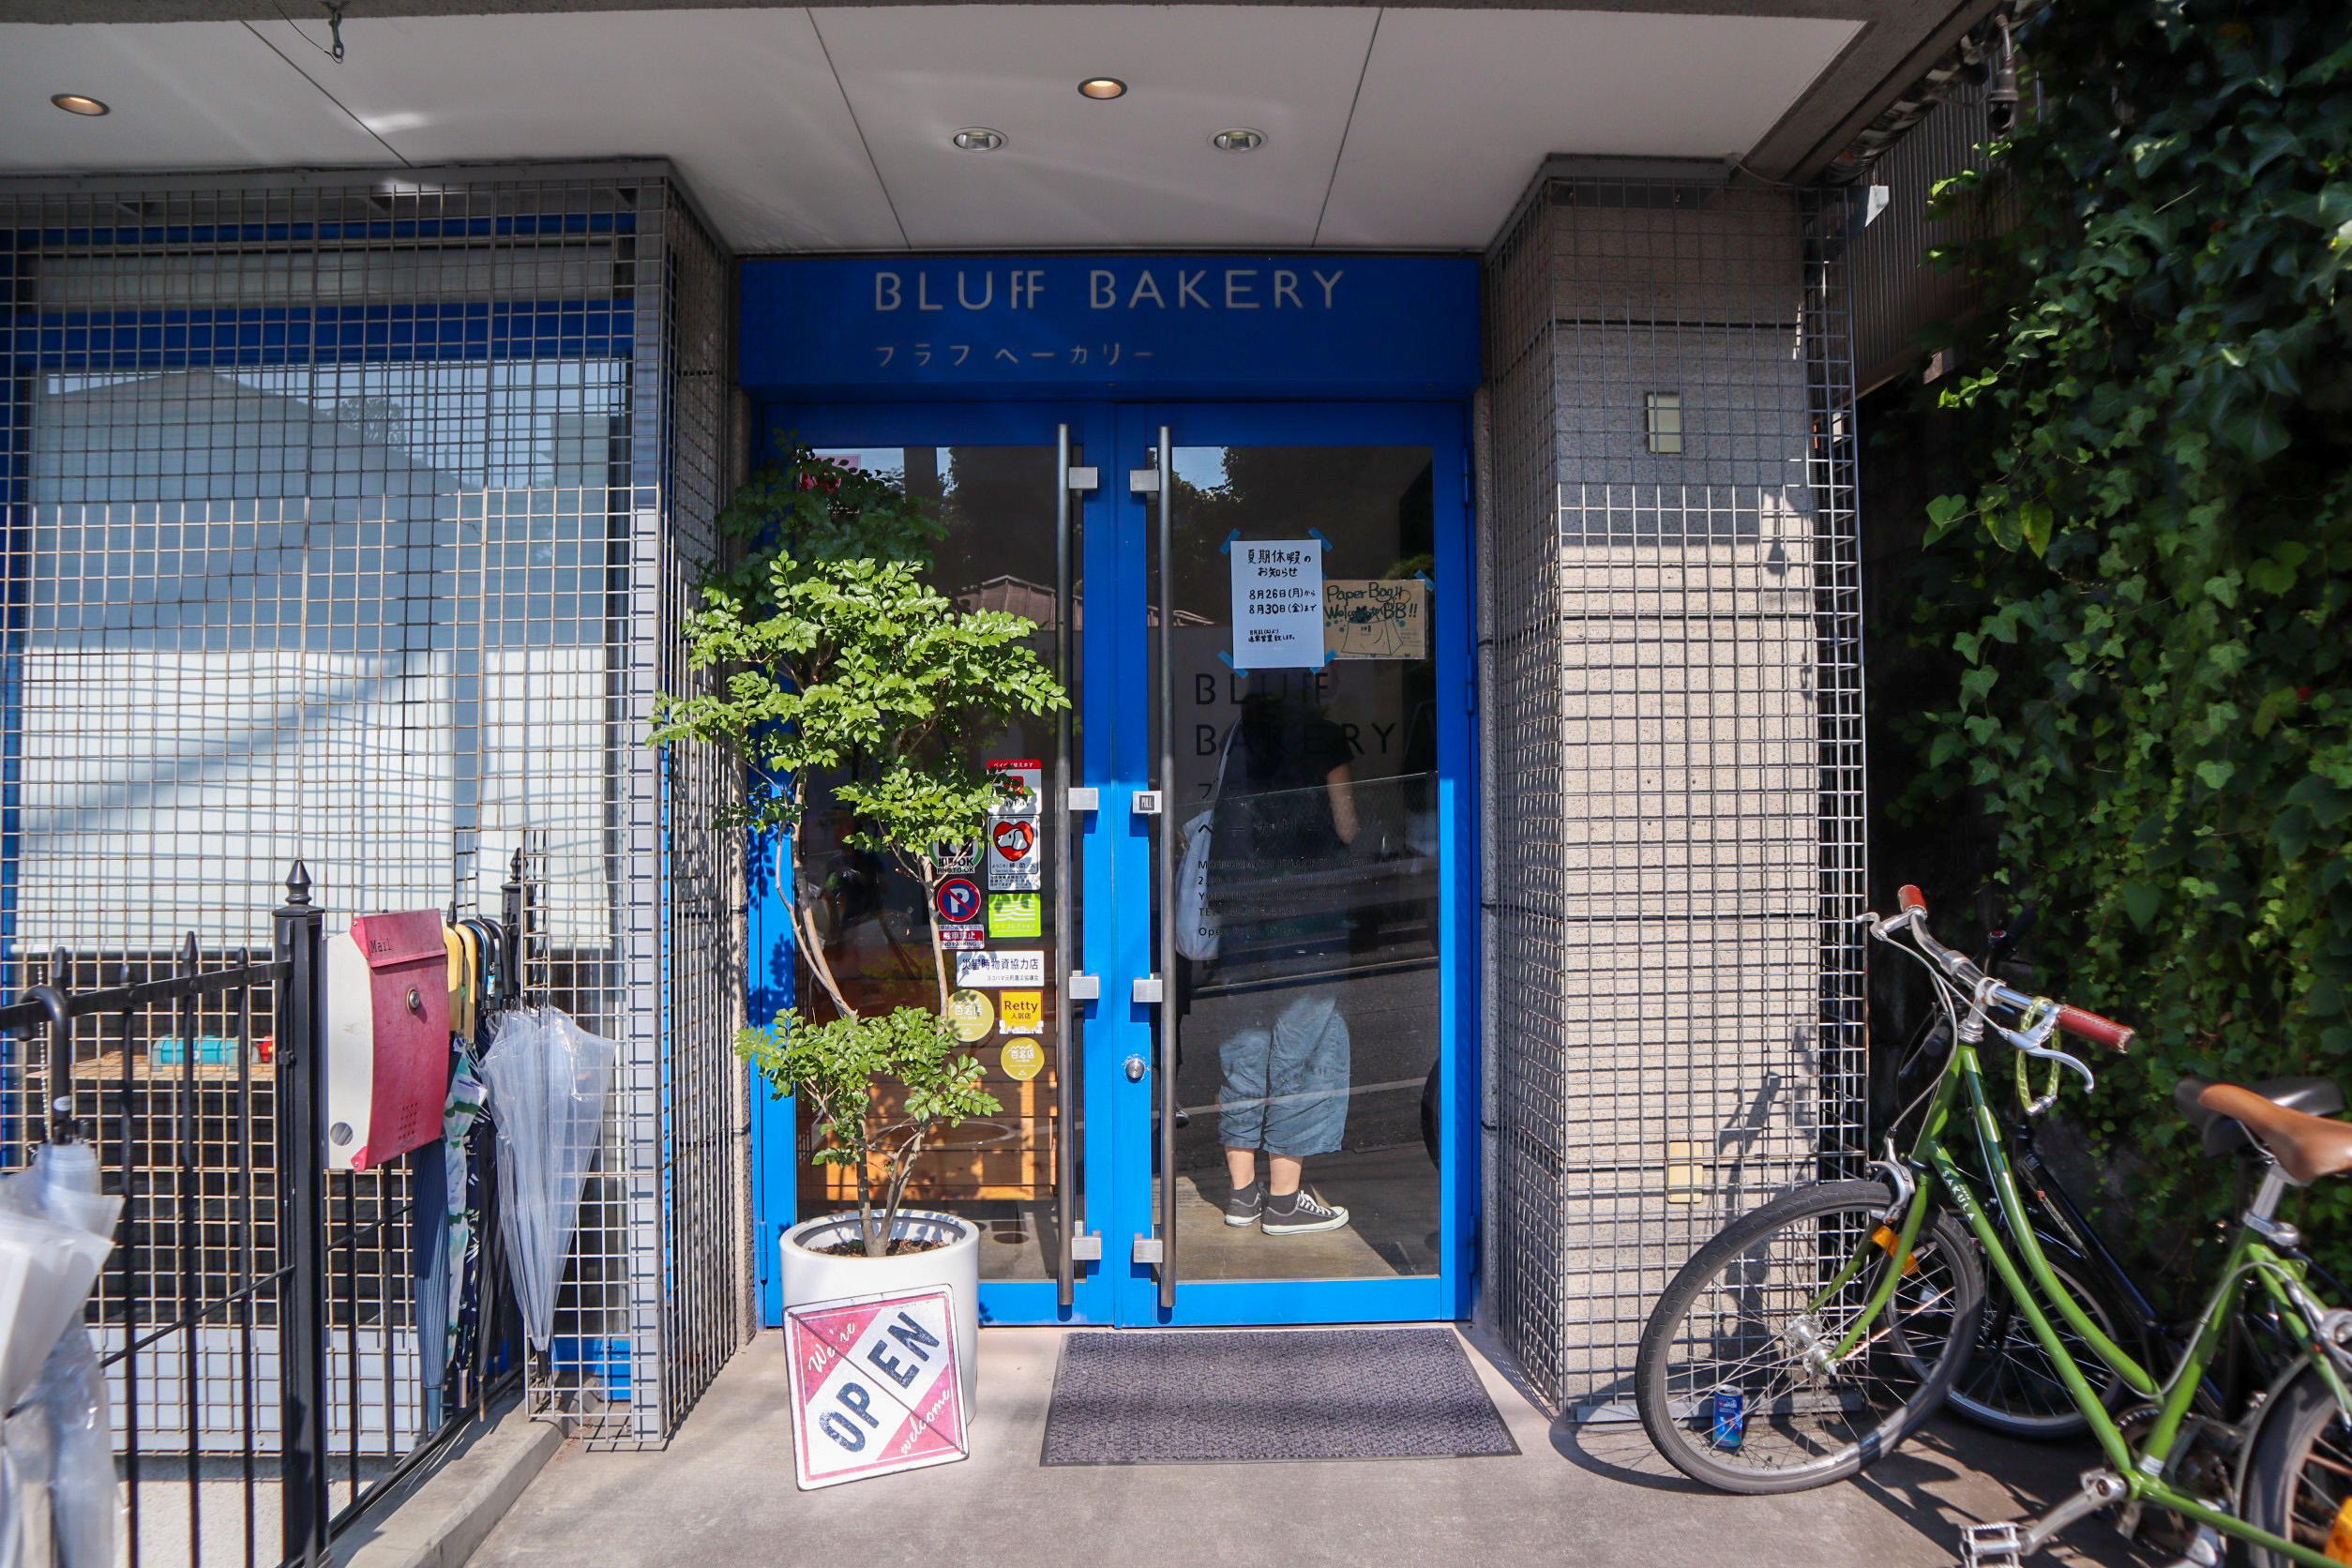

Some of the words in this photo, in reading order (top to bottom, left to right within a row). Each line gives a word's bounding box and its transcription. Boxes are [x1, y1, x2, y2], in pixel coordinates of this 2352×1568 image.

[873, 270, 1046, 312] BLUFF
[1089, 268, 1346, 310] BAKERY
[1246, 549, 1312, 565] 夏期休暇の
[1257, 566, 1298, 579] お知らせ
[1248, 587, 1317, 601] 8月26日(月)から
[1326, 584, 1367, 606] Paper
[1248, 603, 1318, 616] 8月30日(金)まで
[369, 938, 393, 954] Mail
[961, 957, 1040, 972] 災害時物資協力店
[1003, 1000, 1039, 1014] Retty
[1942, 1170, 1975, 1221] SAKULA
[819, 1311, 941, 1453] OPEN
[898, 1387, 951, 1455] welcome
